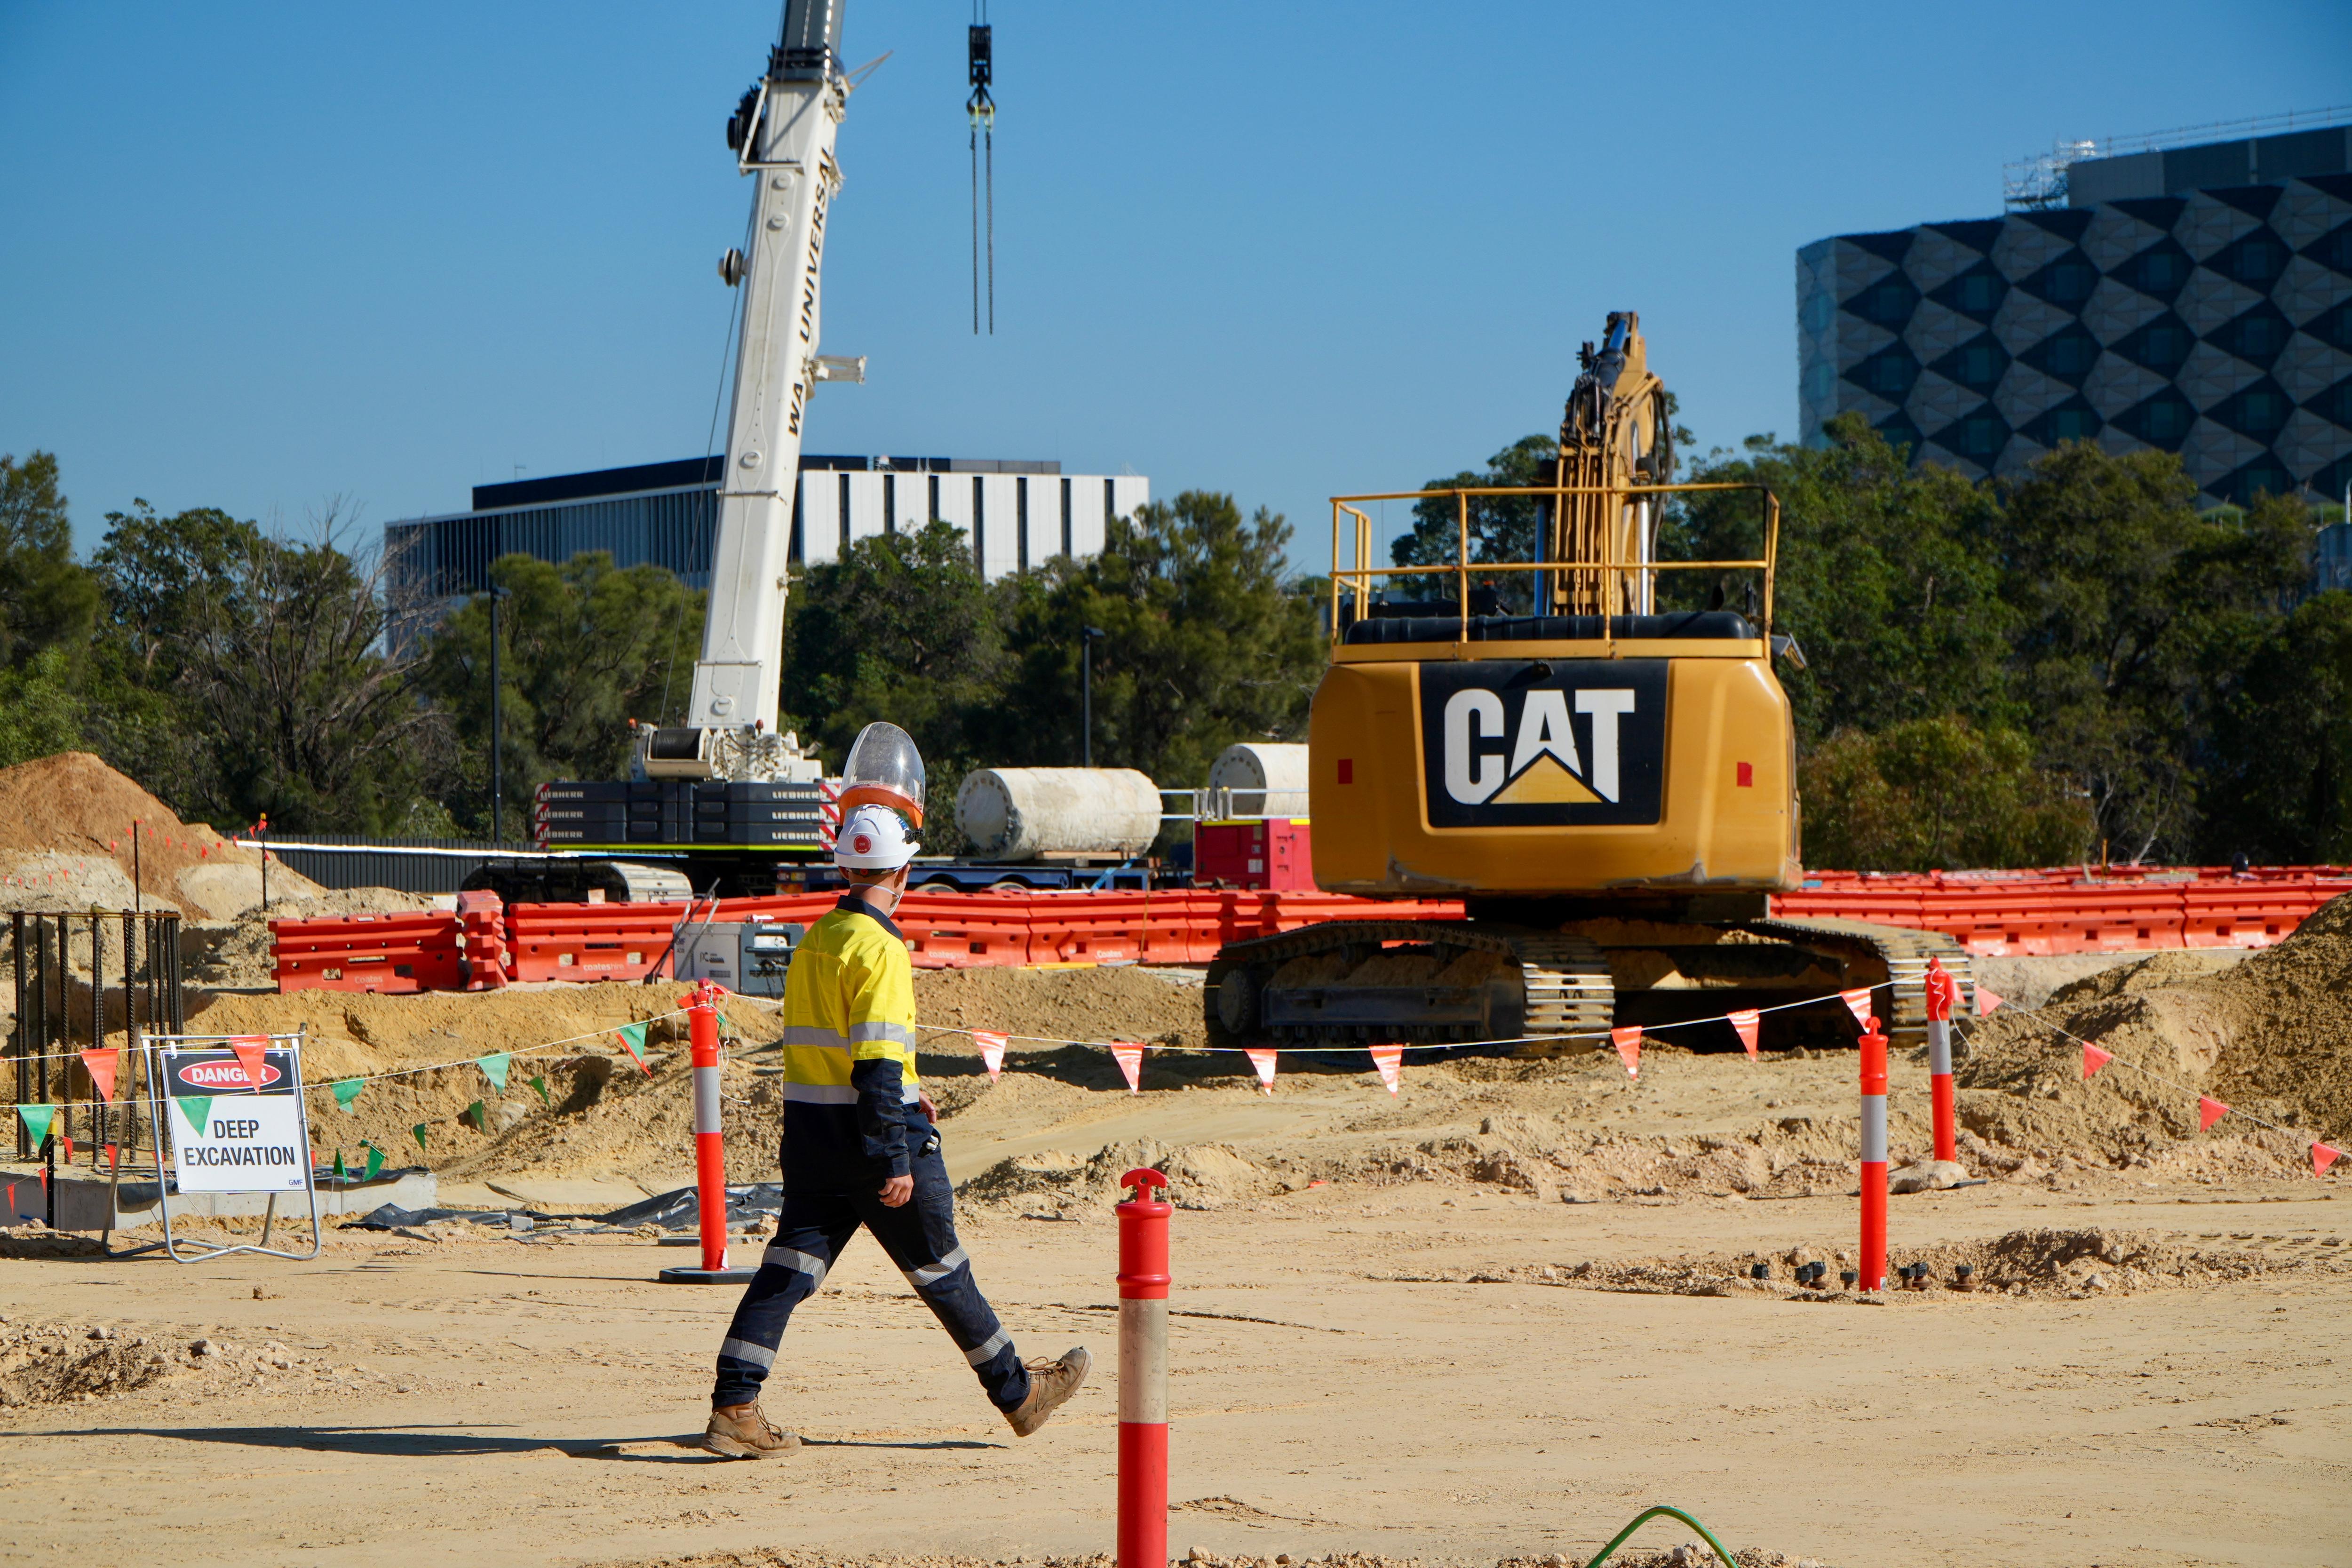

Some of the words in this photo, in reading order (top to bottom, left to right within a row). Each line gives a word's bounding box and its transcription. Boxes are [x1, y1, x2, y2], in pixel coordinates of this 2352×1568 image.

[789, 383, 803, 436] WA
[800, 146, 832, 343] UNIVERSAL
[1445, 688, 1635, 804] CAT
[354, 975, 383, 984] Coates
[213, 1120, 259, 1138] DEEP
[184, 1146, 295, 1166] EXCAVATION
